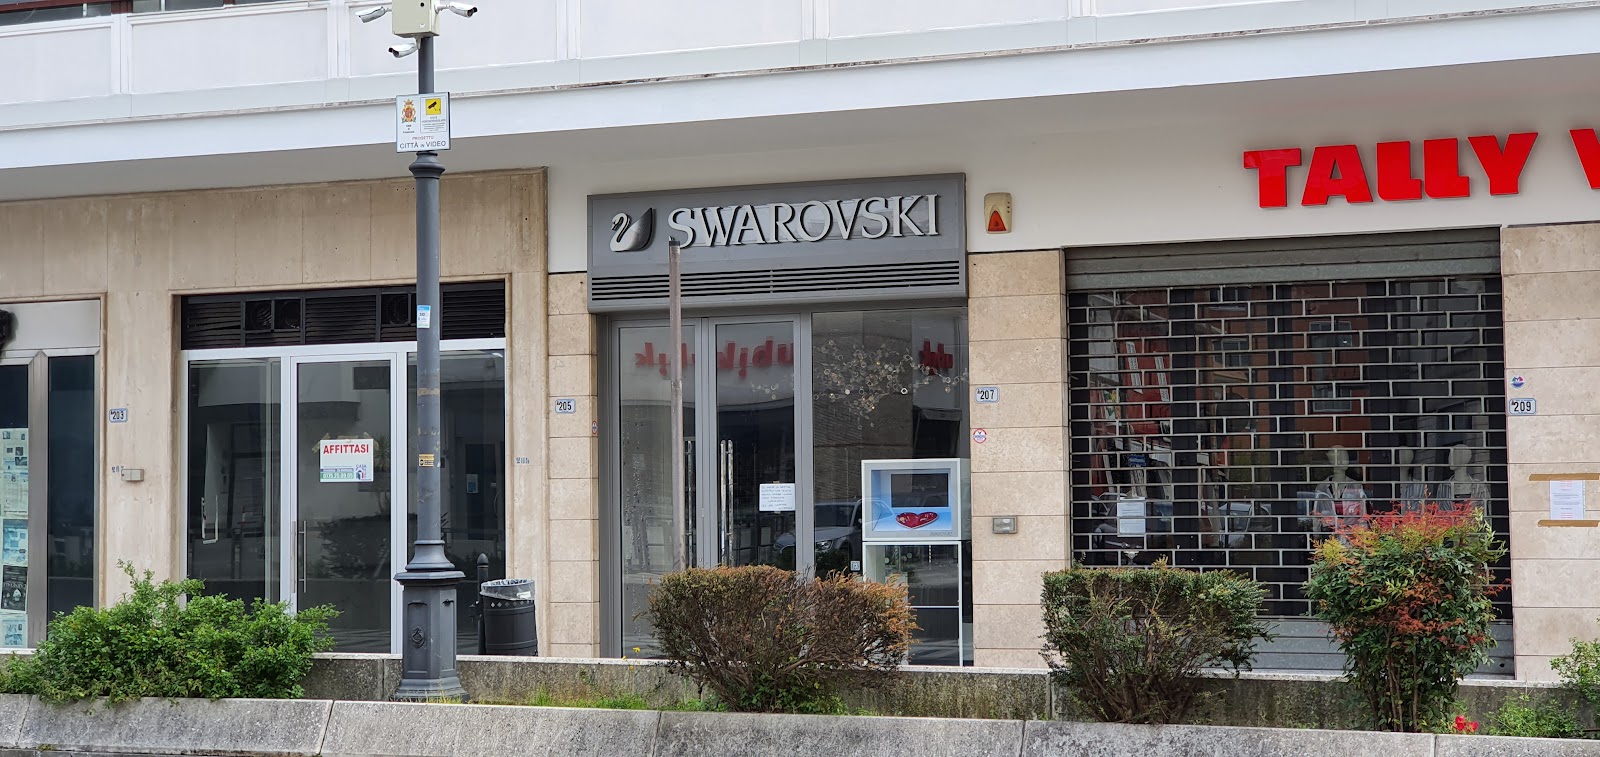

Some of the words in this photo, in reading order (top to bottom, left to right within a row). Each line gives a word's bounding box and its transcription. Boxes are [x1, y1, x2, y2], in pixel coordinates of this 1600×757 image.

[400, 141, 419, 149] CITTÀ
[1244, 132, 1539, 208] TALLY
[667, 194, 939, 249] SWAROVSKI
[323, 443, 369, 454] AFFITTASI
